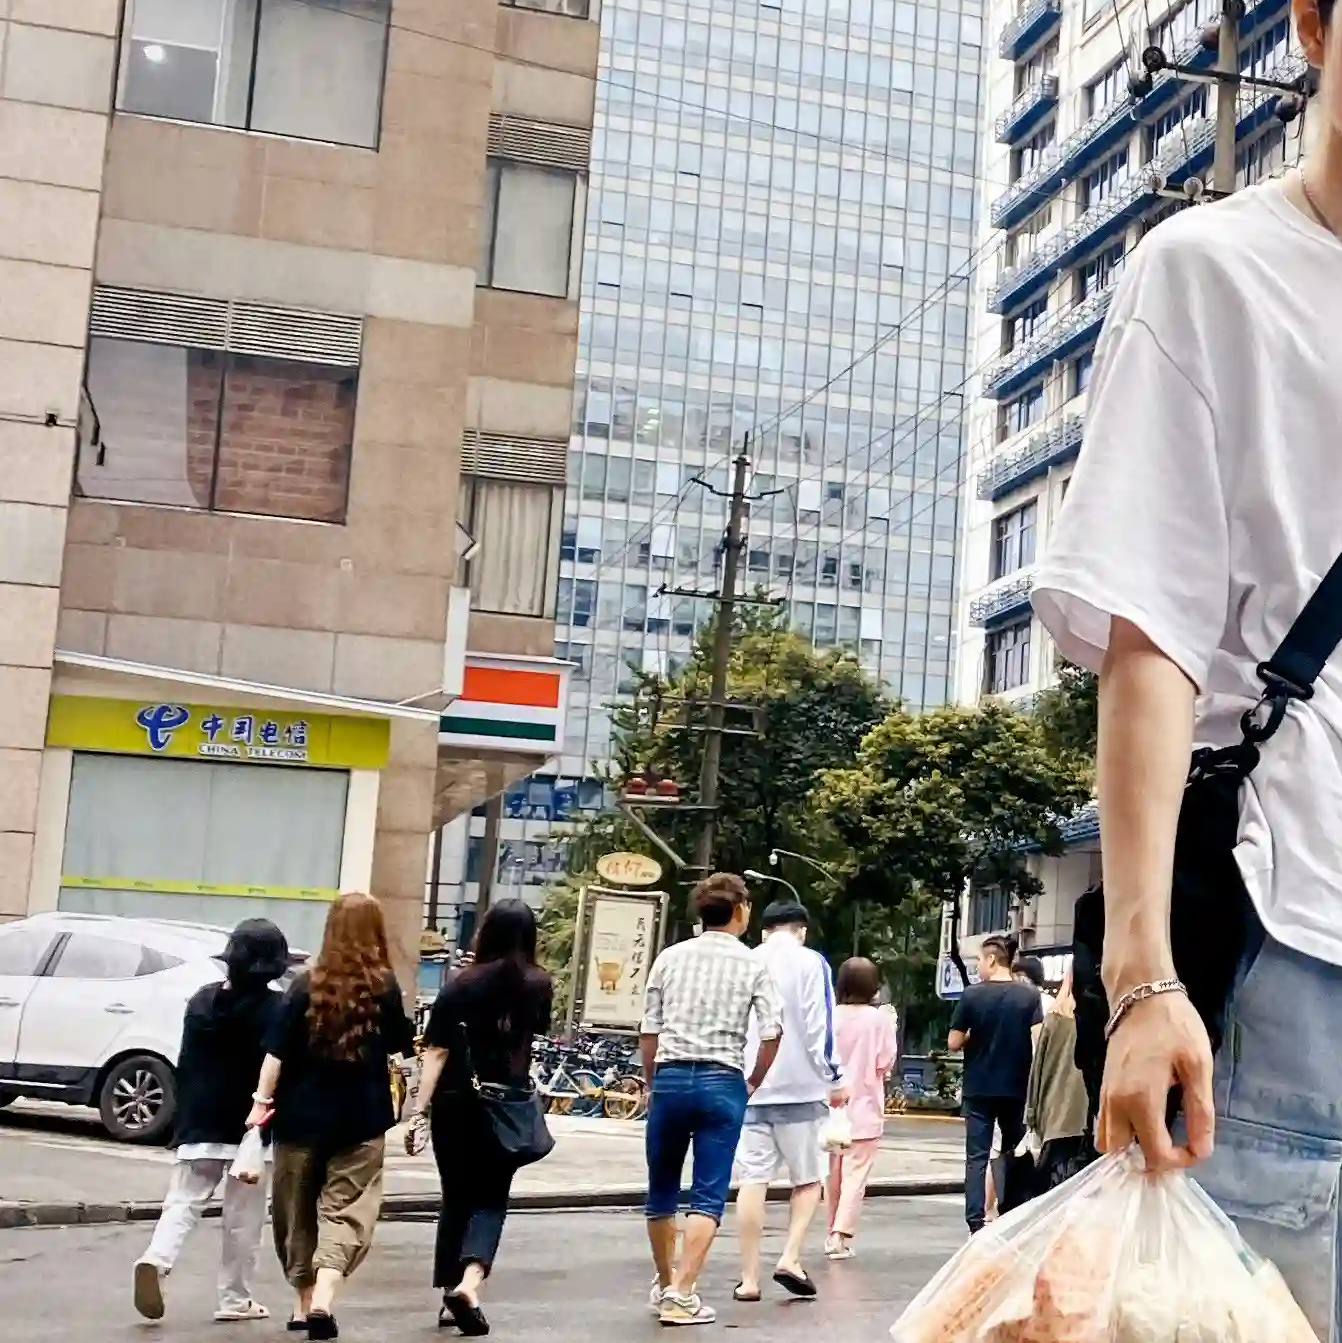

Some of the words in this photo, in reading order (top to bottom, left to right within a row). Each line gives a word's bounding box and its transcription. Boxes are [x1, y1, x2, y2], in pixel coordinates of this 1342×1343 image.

[200, 713, 307, 746] 中国电信
[198, 743, 239, 756] CHINA
[247, 747, 307, 760] TELECOM
